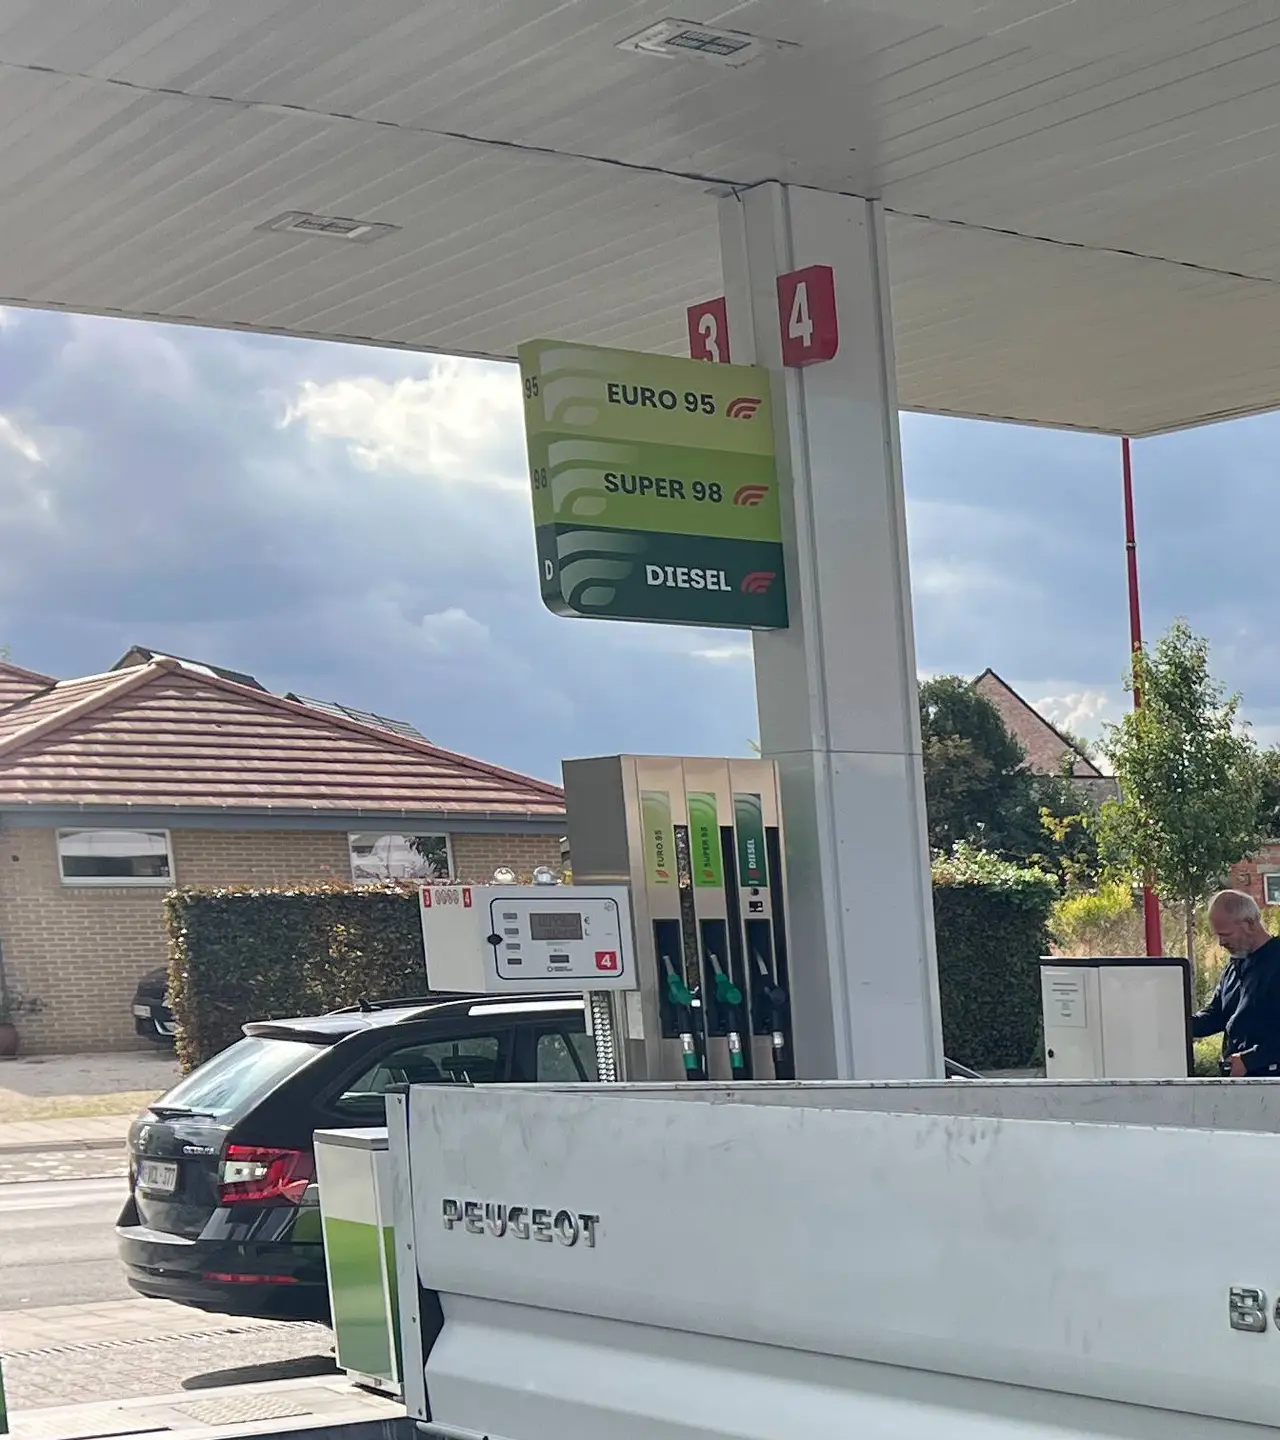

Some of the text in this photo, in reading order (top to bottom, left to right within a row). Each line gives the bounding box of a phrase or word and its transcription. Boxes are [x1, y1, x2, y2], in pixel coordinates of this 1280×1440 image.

[789, 282, 813, 347] 4
[698, 312, 720, 363] 3
[525, 377, 539, 399] 95
[607, 383, 716, 415] EURO 95
[534, 468, 548, 490] 98
[604, 472, 723, 504] SUPER 98
[544, 559, 554, 581] D
[645, 564, 732, 592] DIESEL
[747, 838, 757, 869] DIESEL
[600, 954, 612, 968] 4
[442, 1198, 600, 1249] PEUGEOT
